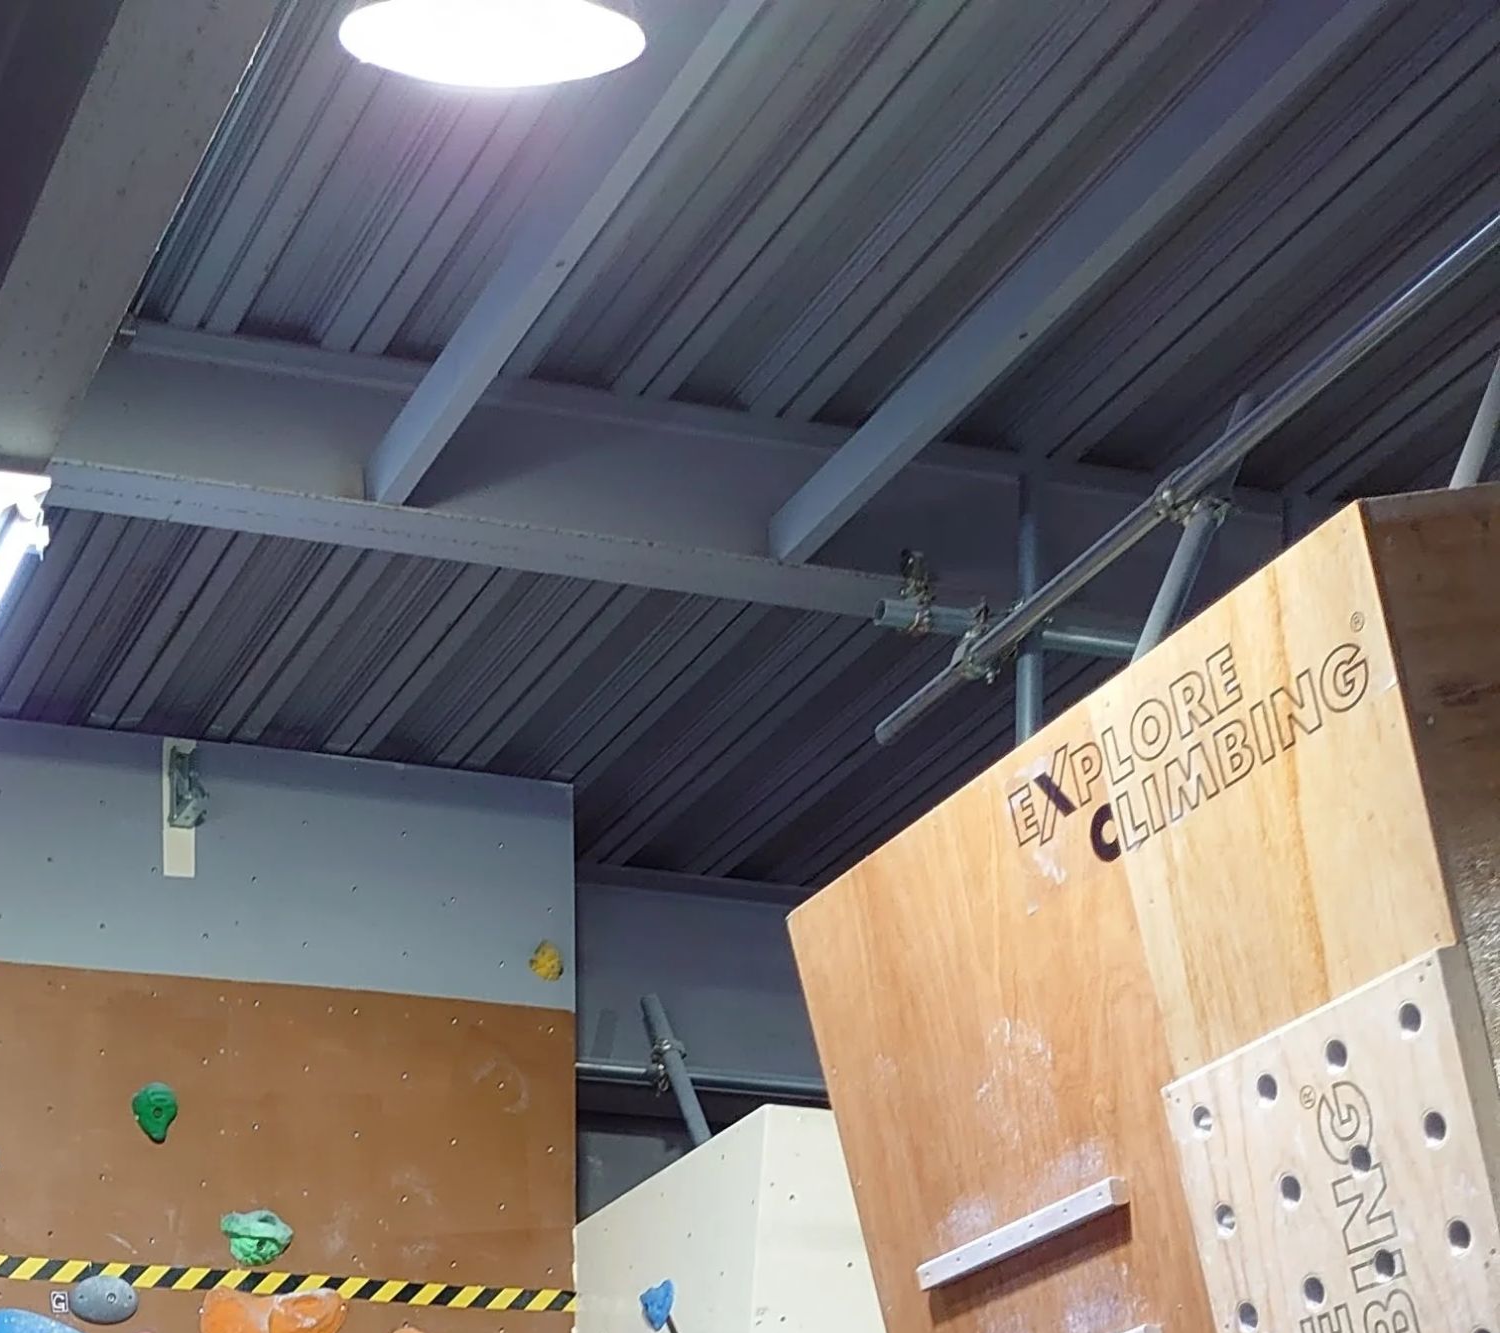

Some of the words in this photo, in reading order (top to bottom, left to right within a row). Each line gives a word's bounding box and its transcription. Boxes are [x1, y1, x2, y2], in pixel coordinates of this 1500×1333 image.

[1008, 643, 1243, 847] EXPLORE
[1090, 642, 1369, 863] CLIMBING
[53, 1294, 65, 1310] G
